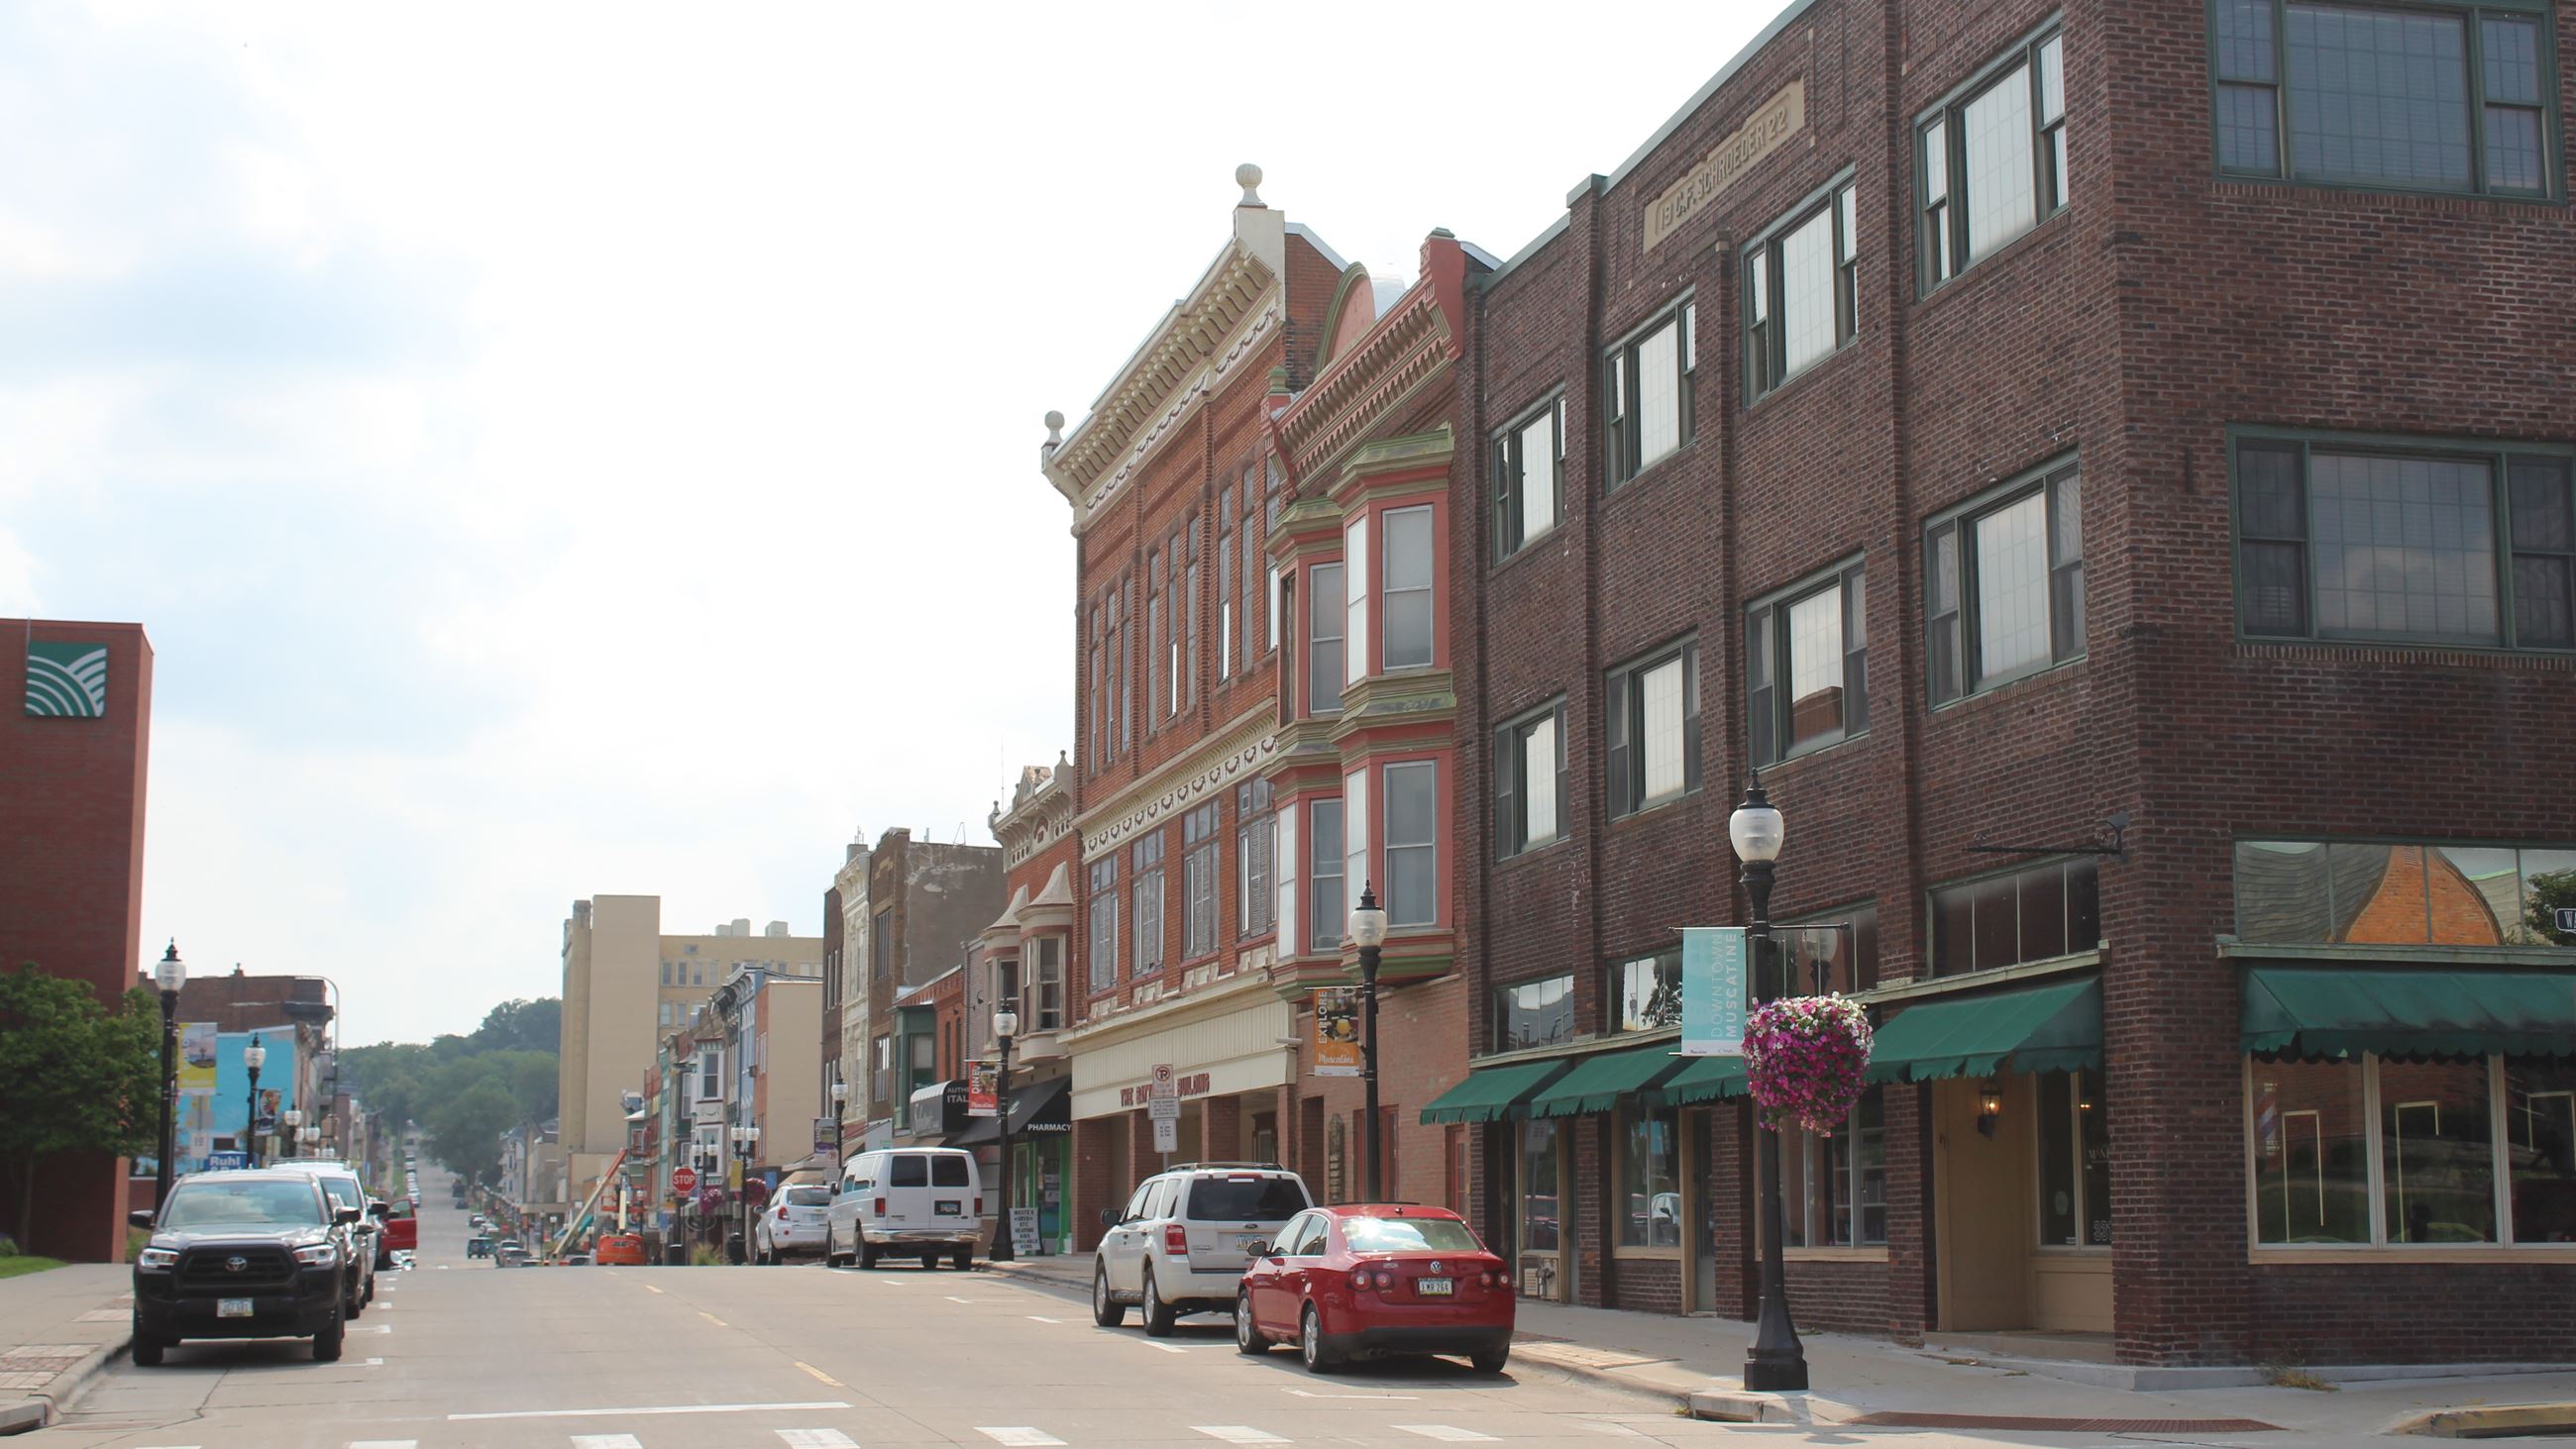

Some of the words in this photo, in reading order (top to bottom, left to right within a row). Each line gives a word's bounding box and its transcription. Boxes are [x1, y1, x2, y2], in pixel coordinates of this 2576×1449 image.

[1696, 122, 1766, 200] SCHROEDER
[1769, 107, 1787, 141] 22
[1711, 934, 1723, 1037] DOWNTOWN
[1726, 934, 1737, 1037] MUSCATINE
[1318, 991, 1328, 1044] EXPLORE
[1121, 1087, 1133, 1107] THE
[1177, 1073, 1210, 1097] BUILDING
[1027, 1123, 1071, 1132] PHARMACY
[210, 1156, 240, 1166] Ruhl
[674, 1175, 695, 1185] STOP
